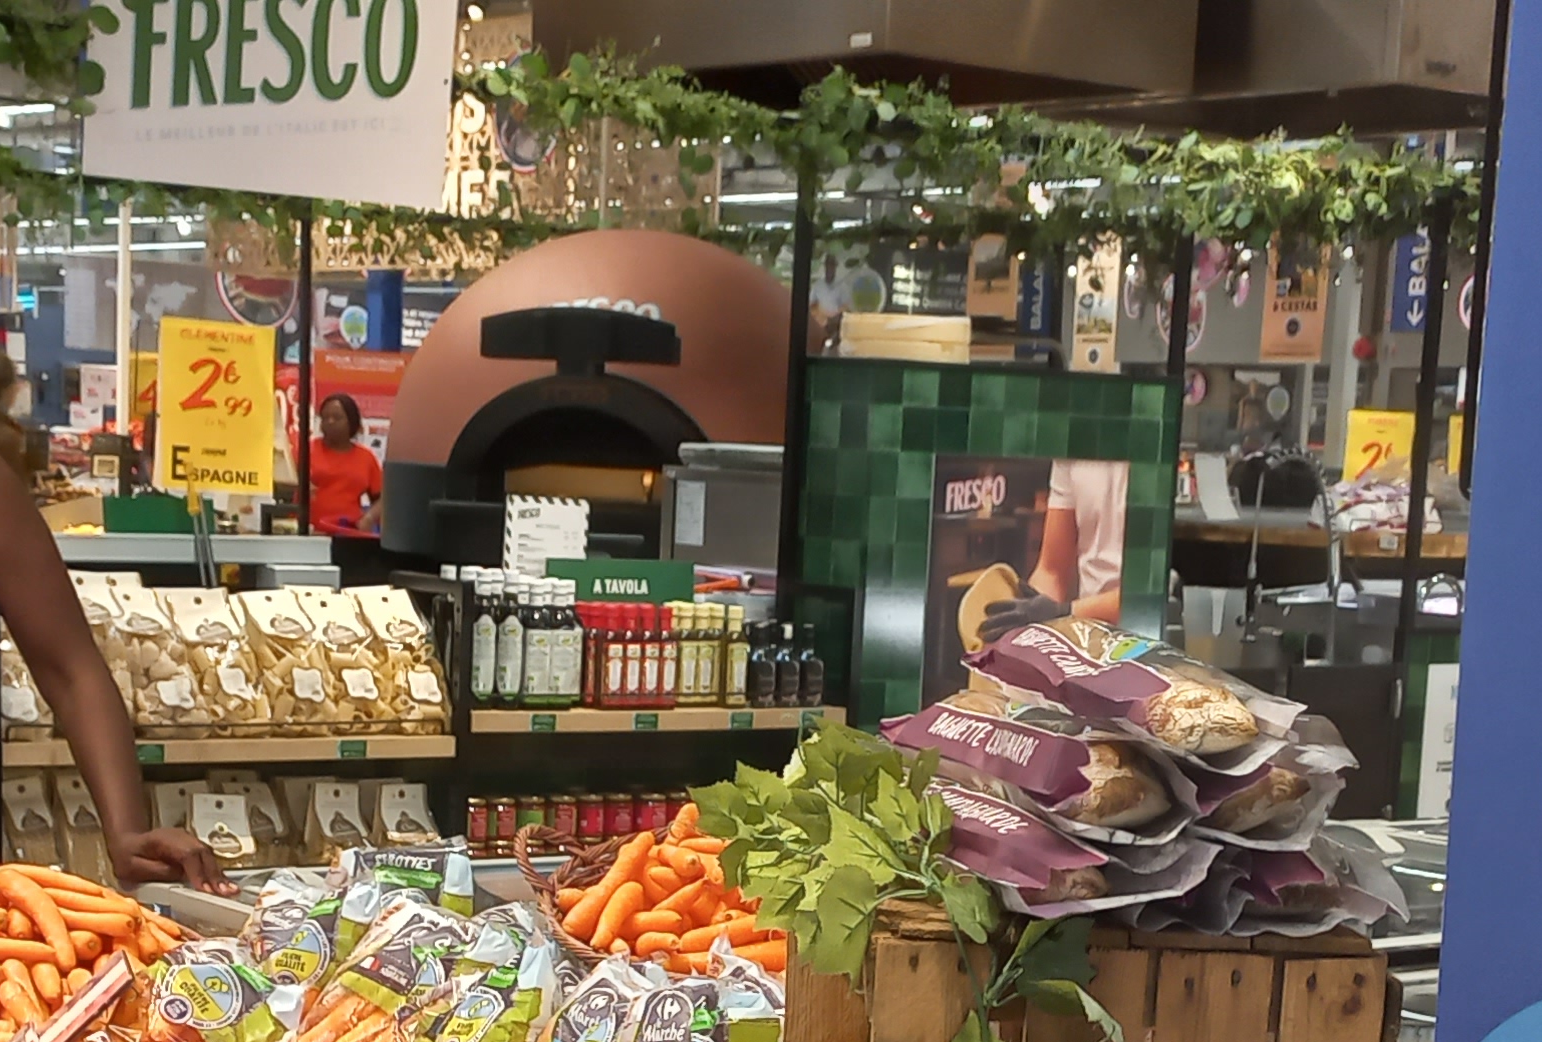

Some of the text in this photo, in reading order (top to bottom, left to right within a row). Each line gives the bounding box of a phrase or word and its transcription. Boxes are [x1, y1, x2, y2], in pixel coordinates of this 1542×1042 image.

[130, 0, 419, 110] FRESCO
[945, 474, 1007, 513] FRESCO
[604, 578, 649, 595] TAVOLA
[927, 711, 994, 748] BAGUETTE
